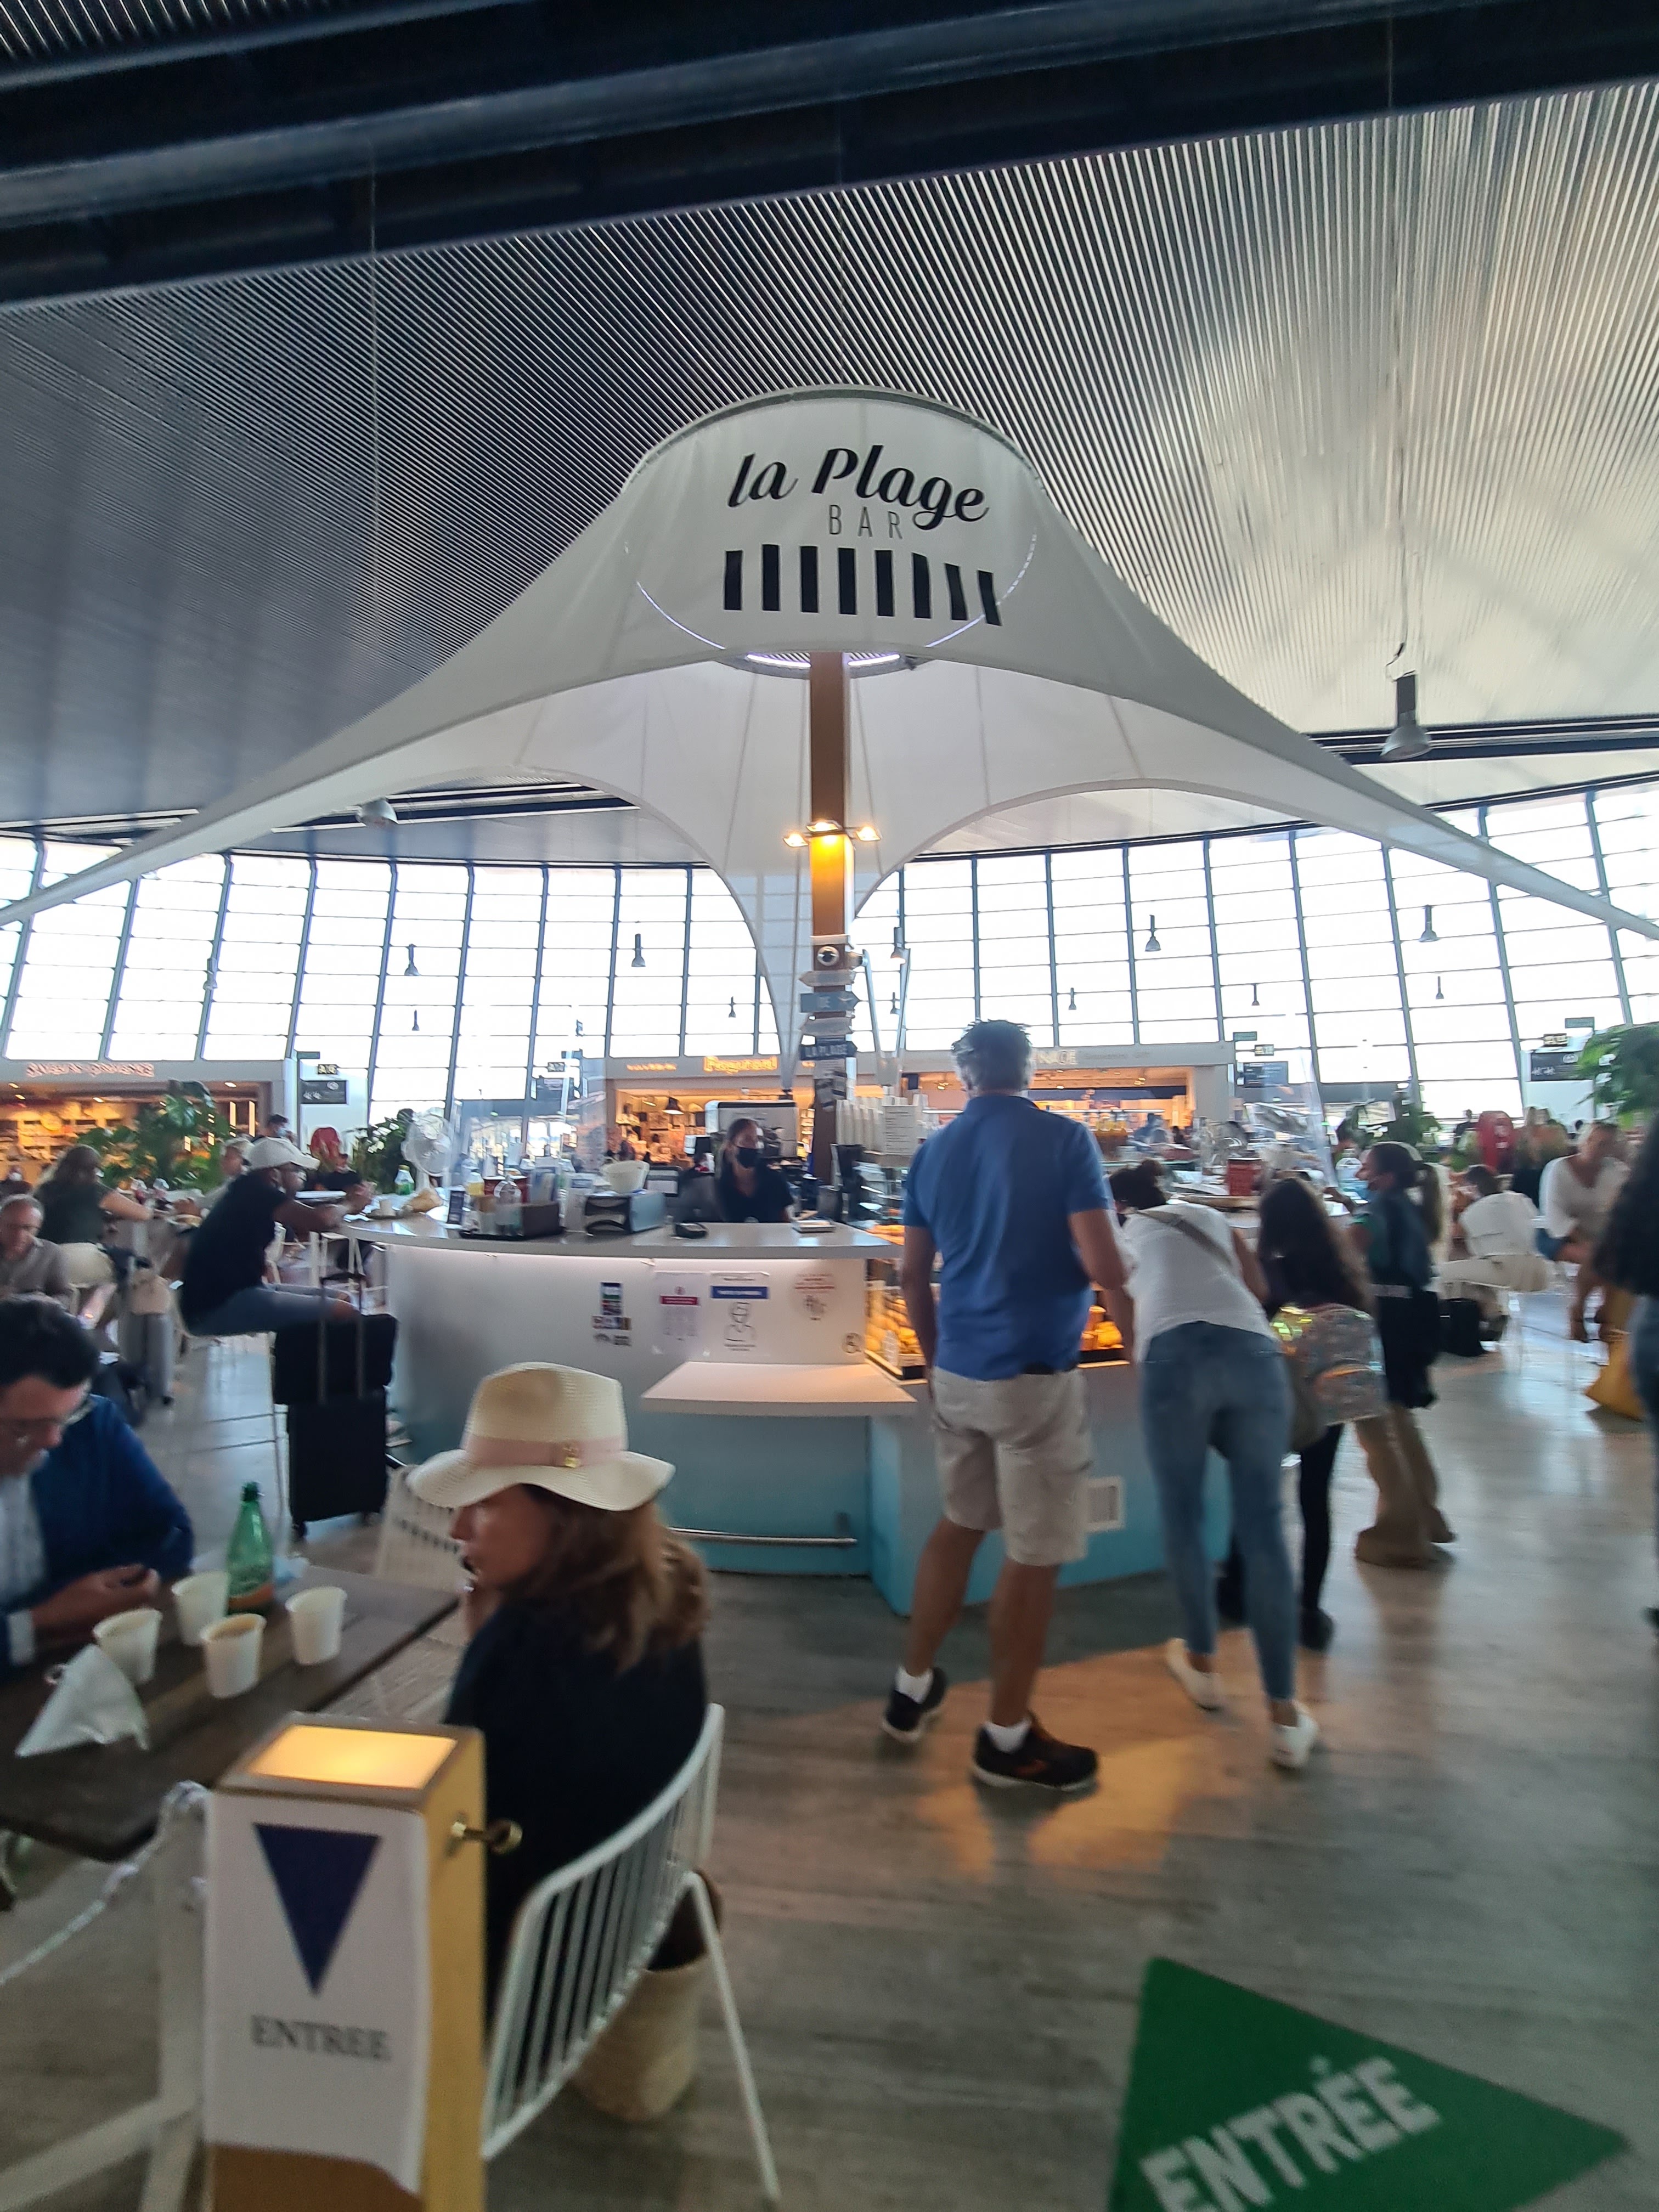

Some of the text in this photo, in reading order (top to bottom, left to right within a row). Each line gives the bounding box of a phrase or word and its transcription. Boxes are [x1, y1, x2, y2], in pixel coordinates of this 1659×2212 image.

[727, 444, 990, 531] la Plage
[828, 504, 904, 539] BAR
[250, 2013, 392, 2062] ENTREE
[1139, 2055, 1442, 2212] ENTRÉE
